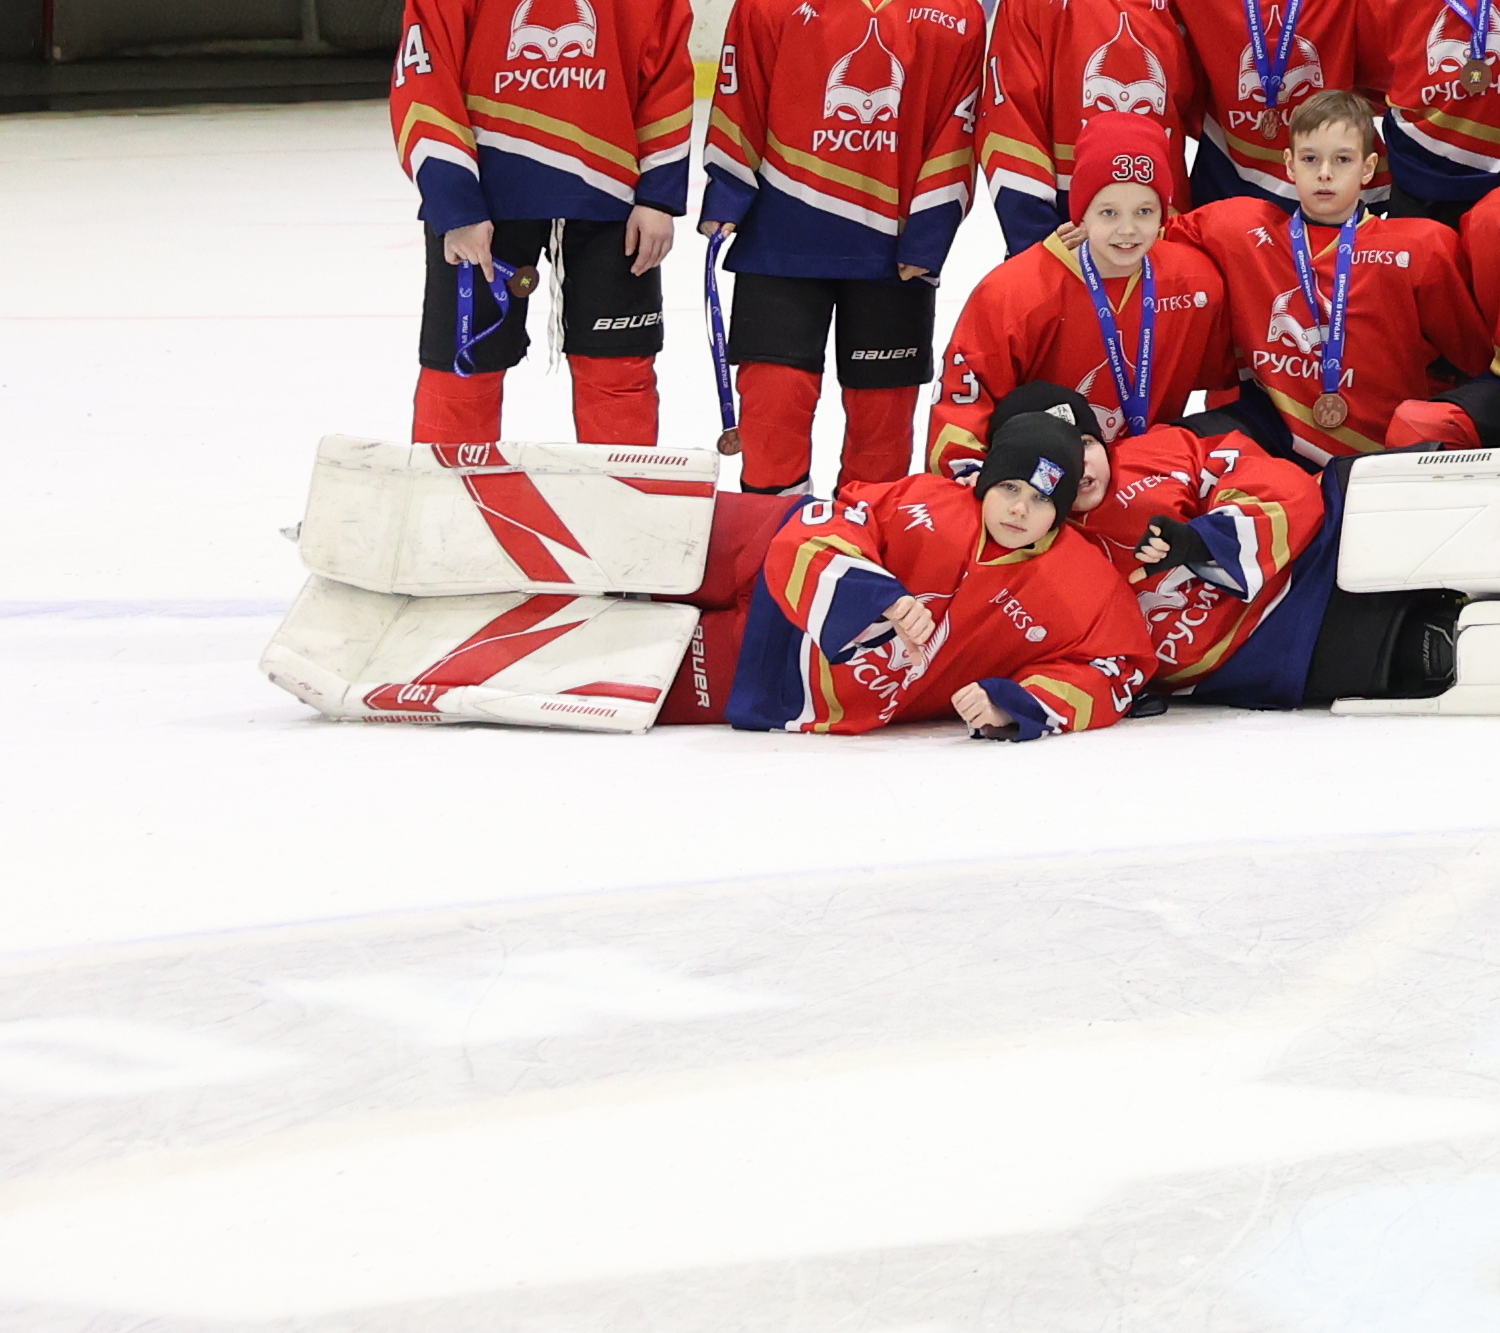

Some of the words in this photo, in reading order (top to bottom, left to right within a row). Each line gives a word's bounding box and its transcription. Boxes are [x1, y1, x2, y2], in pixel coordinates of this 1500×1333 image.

[906, 7, 957, 30] JUTEKS
[494, 67, 606, 93] РУСИЧИ
[812, 128, 898, 153] РУСИЧ
[1112, 155, 1154, 183] 33
[1351, 250, 1393, 265] UTEKS
[1153, 294, 1192, 313] UTEKS
[850, 346, 918, 362] BAUER
[607, 452, 689, 466] WARRIOR
[1417, 451, 1492, 465] WARRIOR
[1116, 472, 1170, 509] JUTEK
